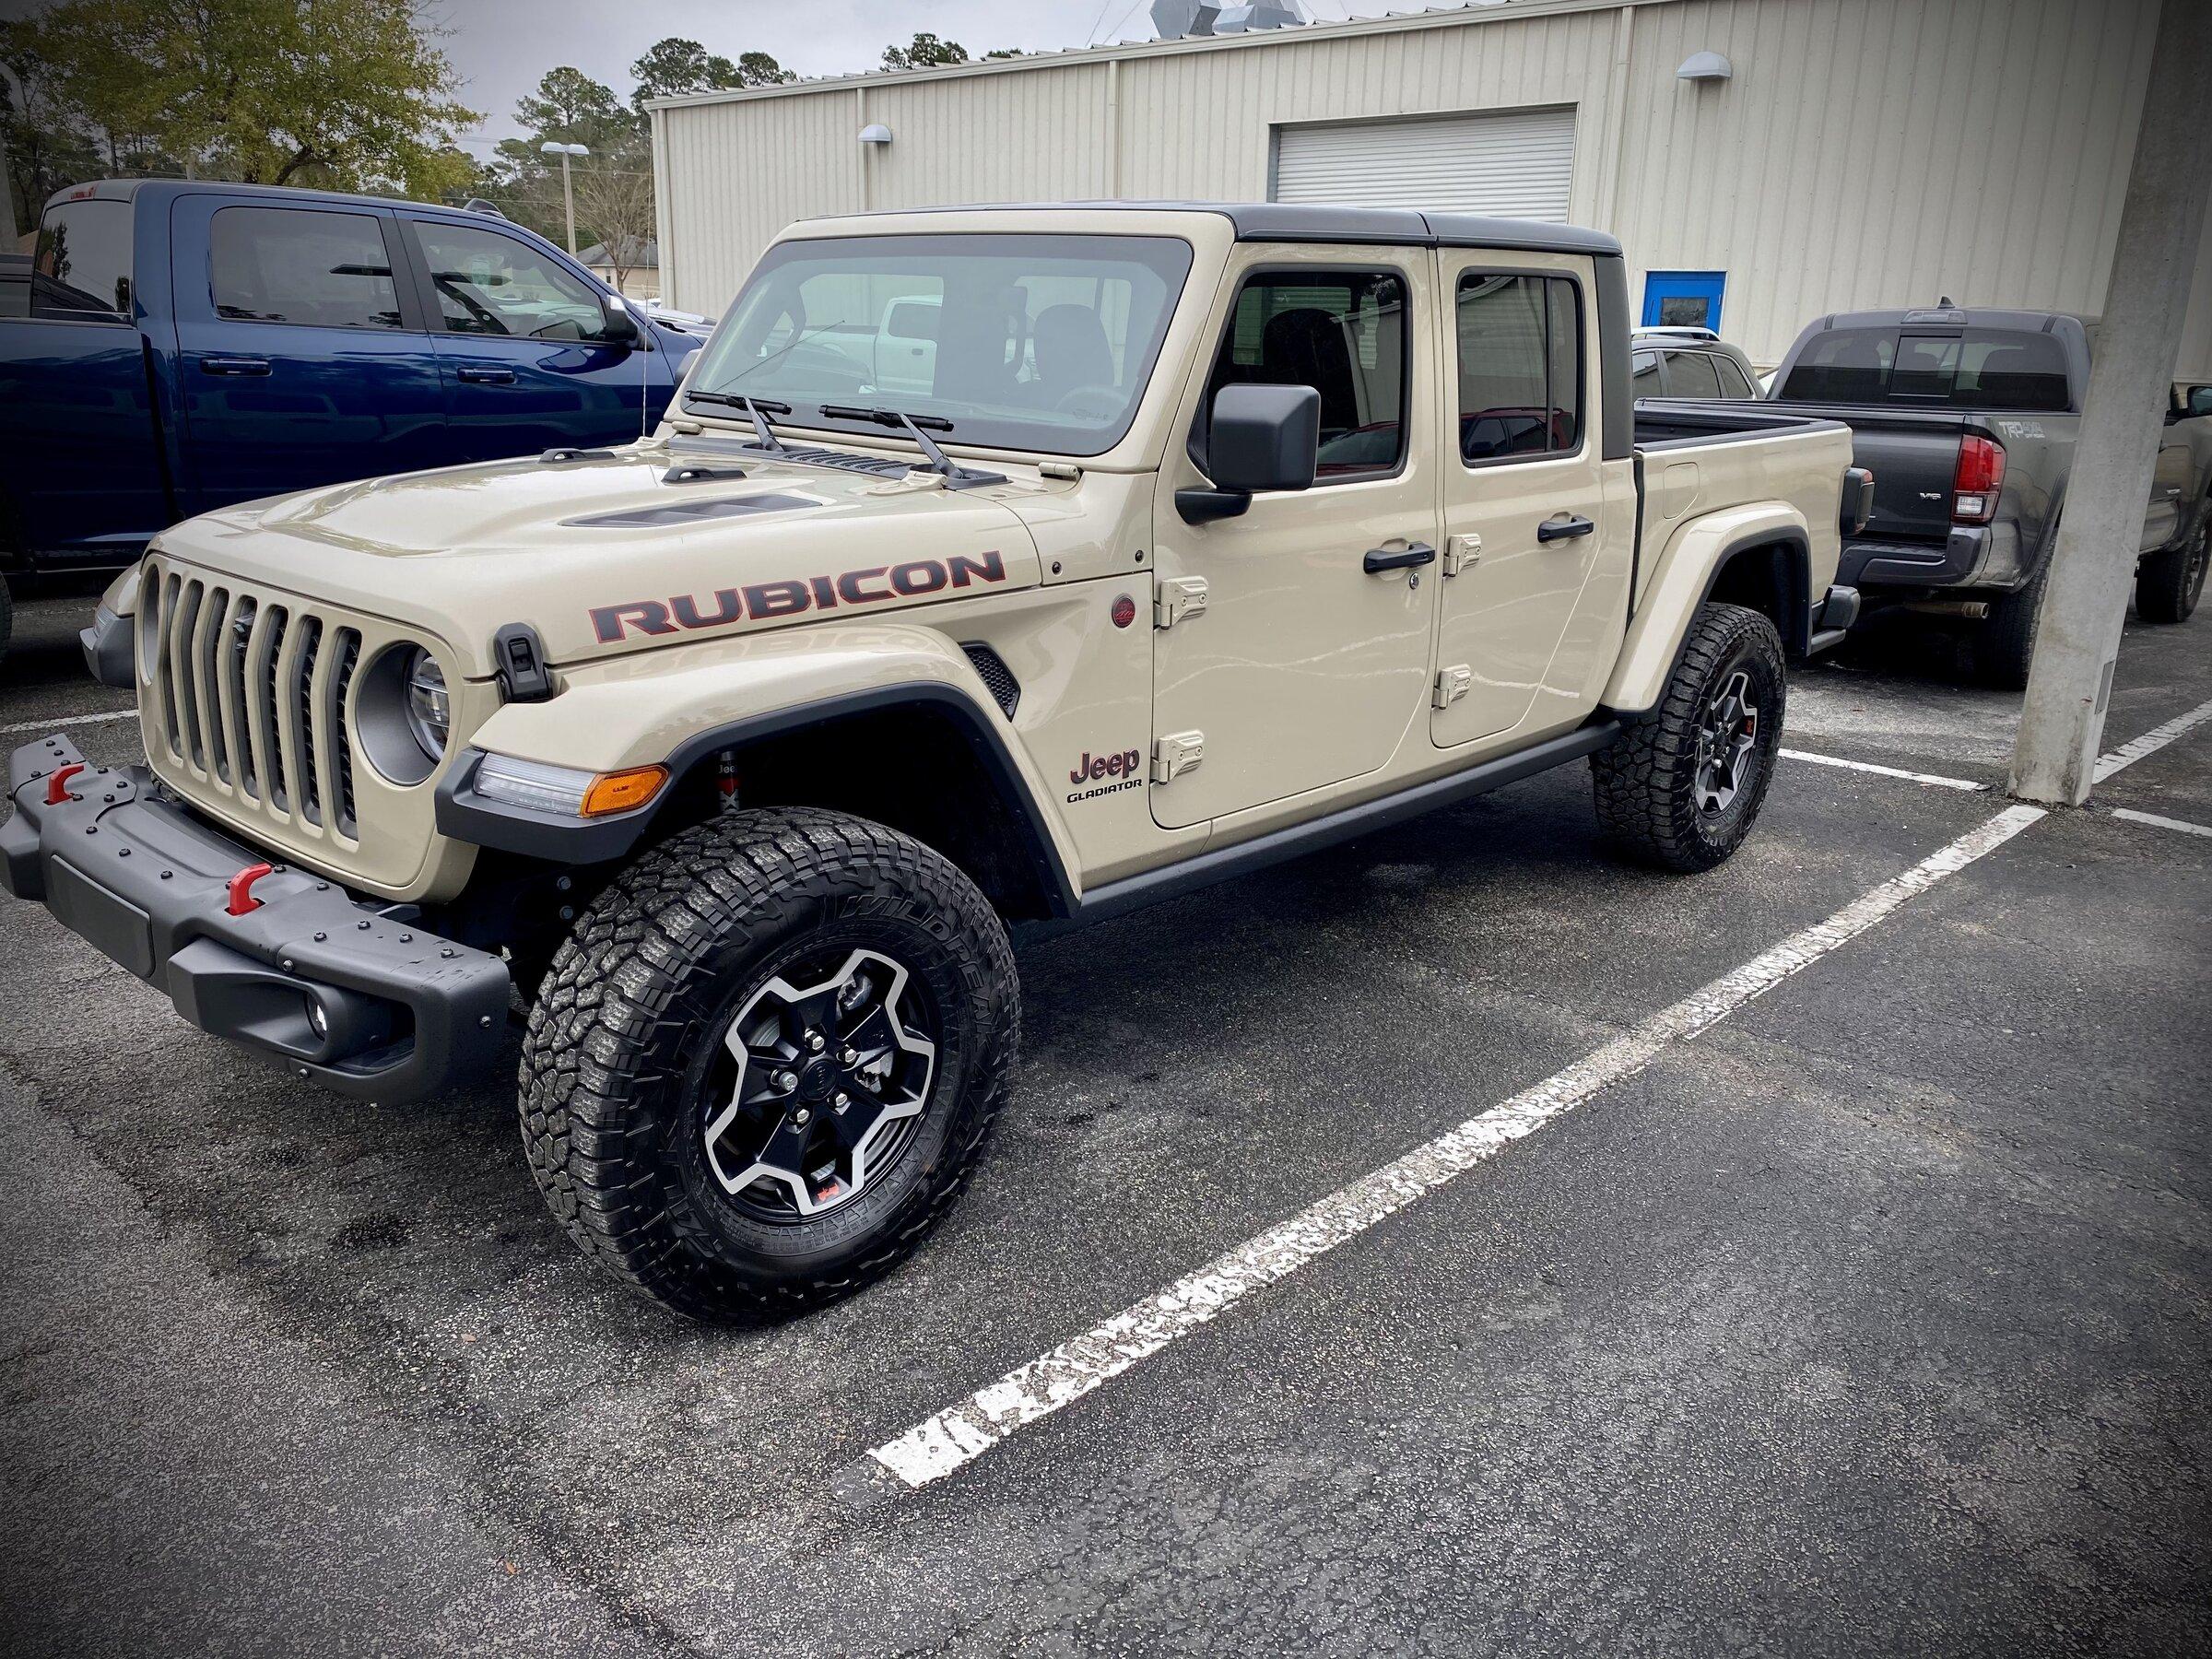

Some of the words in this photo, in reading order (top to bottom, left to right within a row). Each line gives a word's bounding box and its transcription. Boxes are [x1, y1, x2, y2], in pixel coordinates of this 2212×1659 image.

[1919, 492, 1942, 500] V6
[588, 550, 1006, 644] RUBICON
[719, 764, 735, 774] Jee
[1069, 747, 1140, 784] Jeep
[1066, 778, 1143, 804] GLADIATOR
